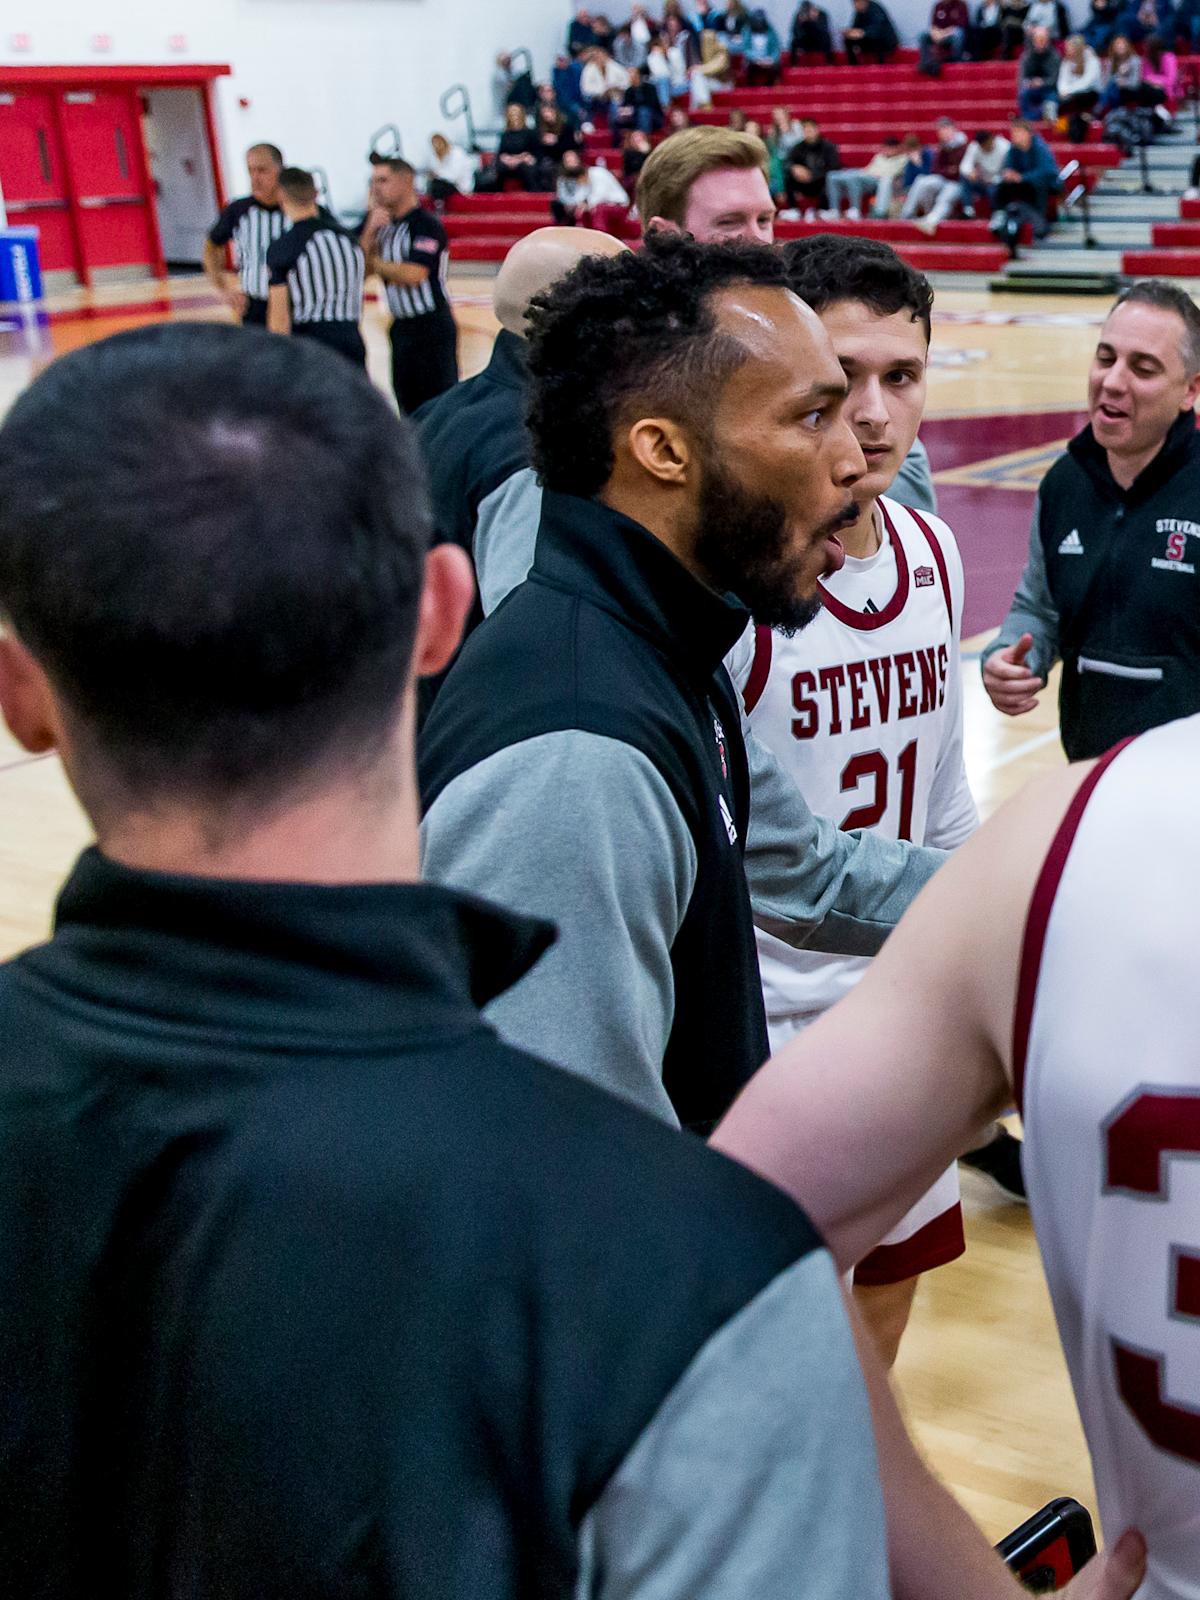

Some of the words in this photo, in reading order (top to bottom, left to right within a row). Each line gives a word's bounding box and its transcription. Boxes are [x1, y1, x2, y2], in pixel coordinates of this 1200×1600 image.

[1165, 532, 1187, 561] S
[791, 643, 948, 741] STEVENS
[838, 737, 918, 842] 21
